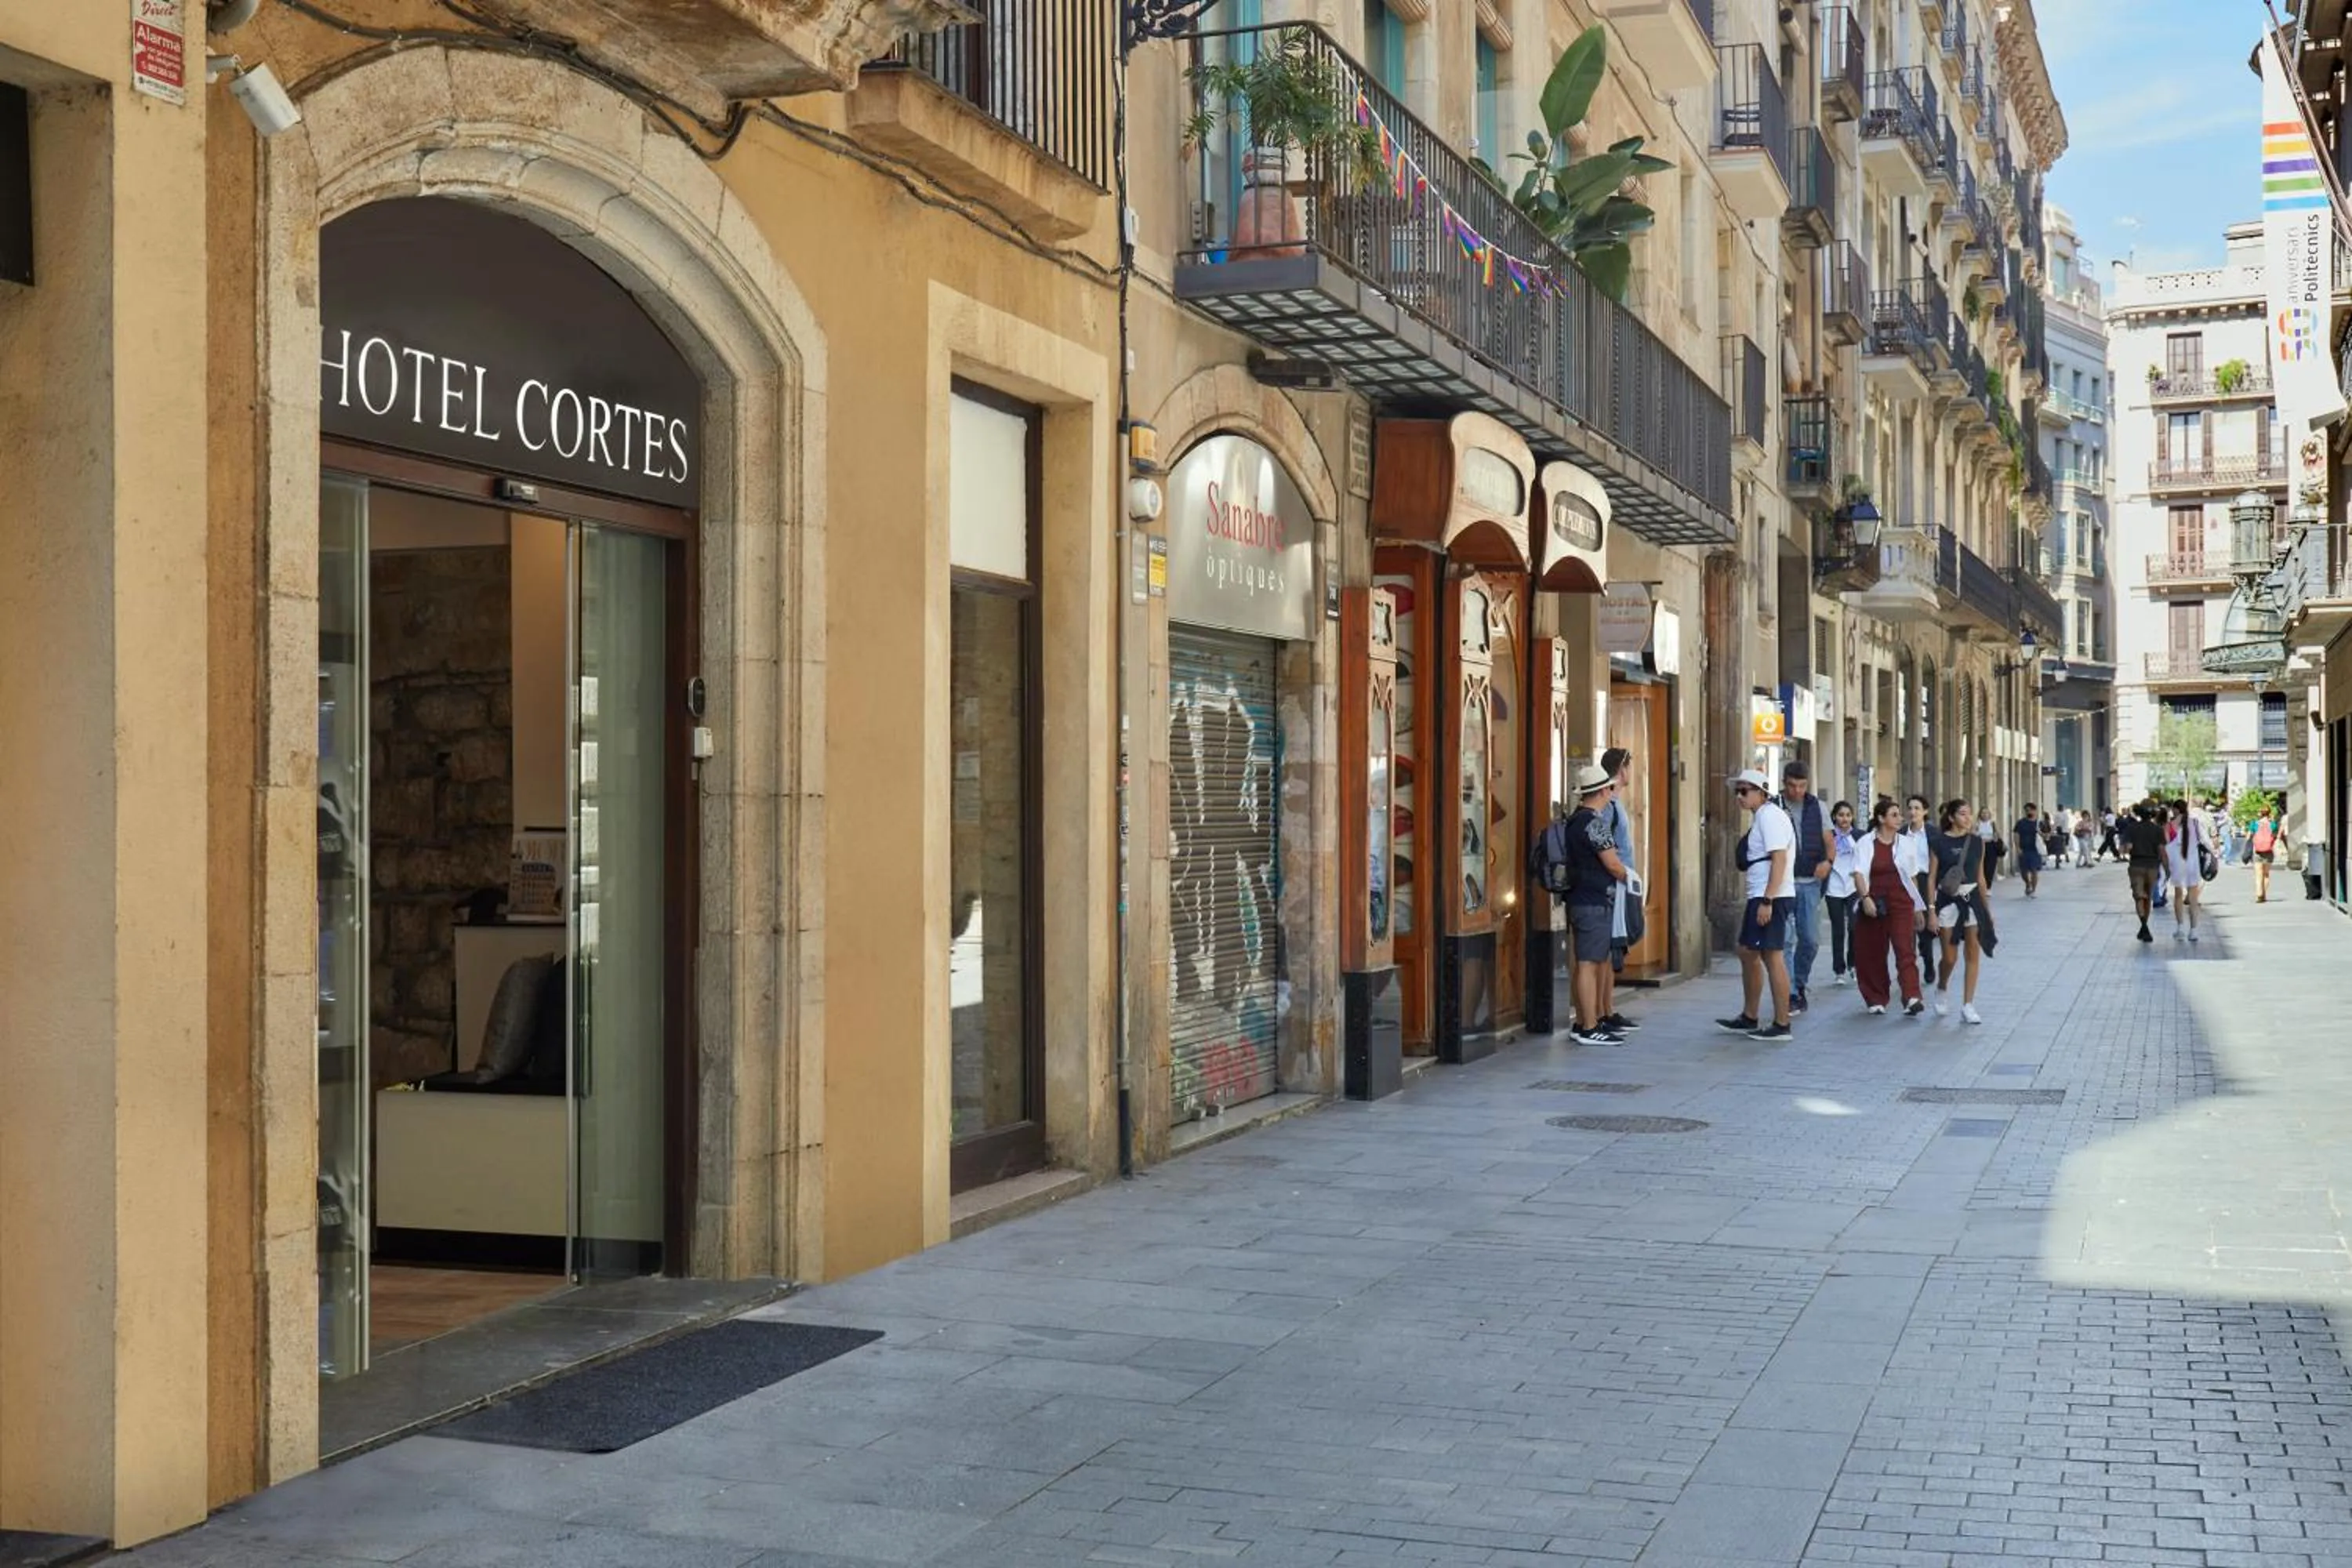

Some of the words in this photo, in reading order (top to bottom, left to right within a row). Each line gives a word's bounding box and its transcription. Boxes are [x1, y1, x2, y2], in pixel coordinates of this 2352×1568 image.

[136, 24, 181, 53] Alarma
[320, 325, 500, 441] HOTEL
[515, 379, 689, 484] CORTES
[1207, 481, 1287, 552] Sanabre
